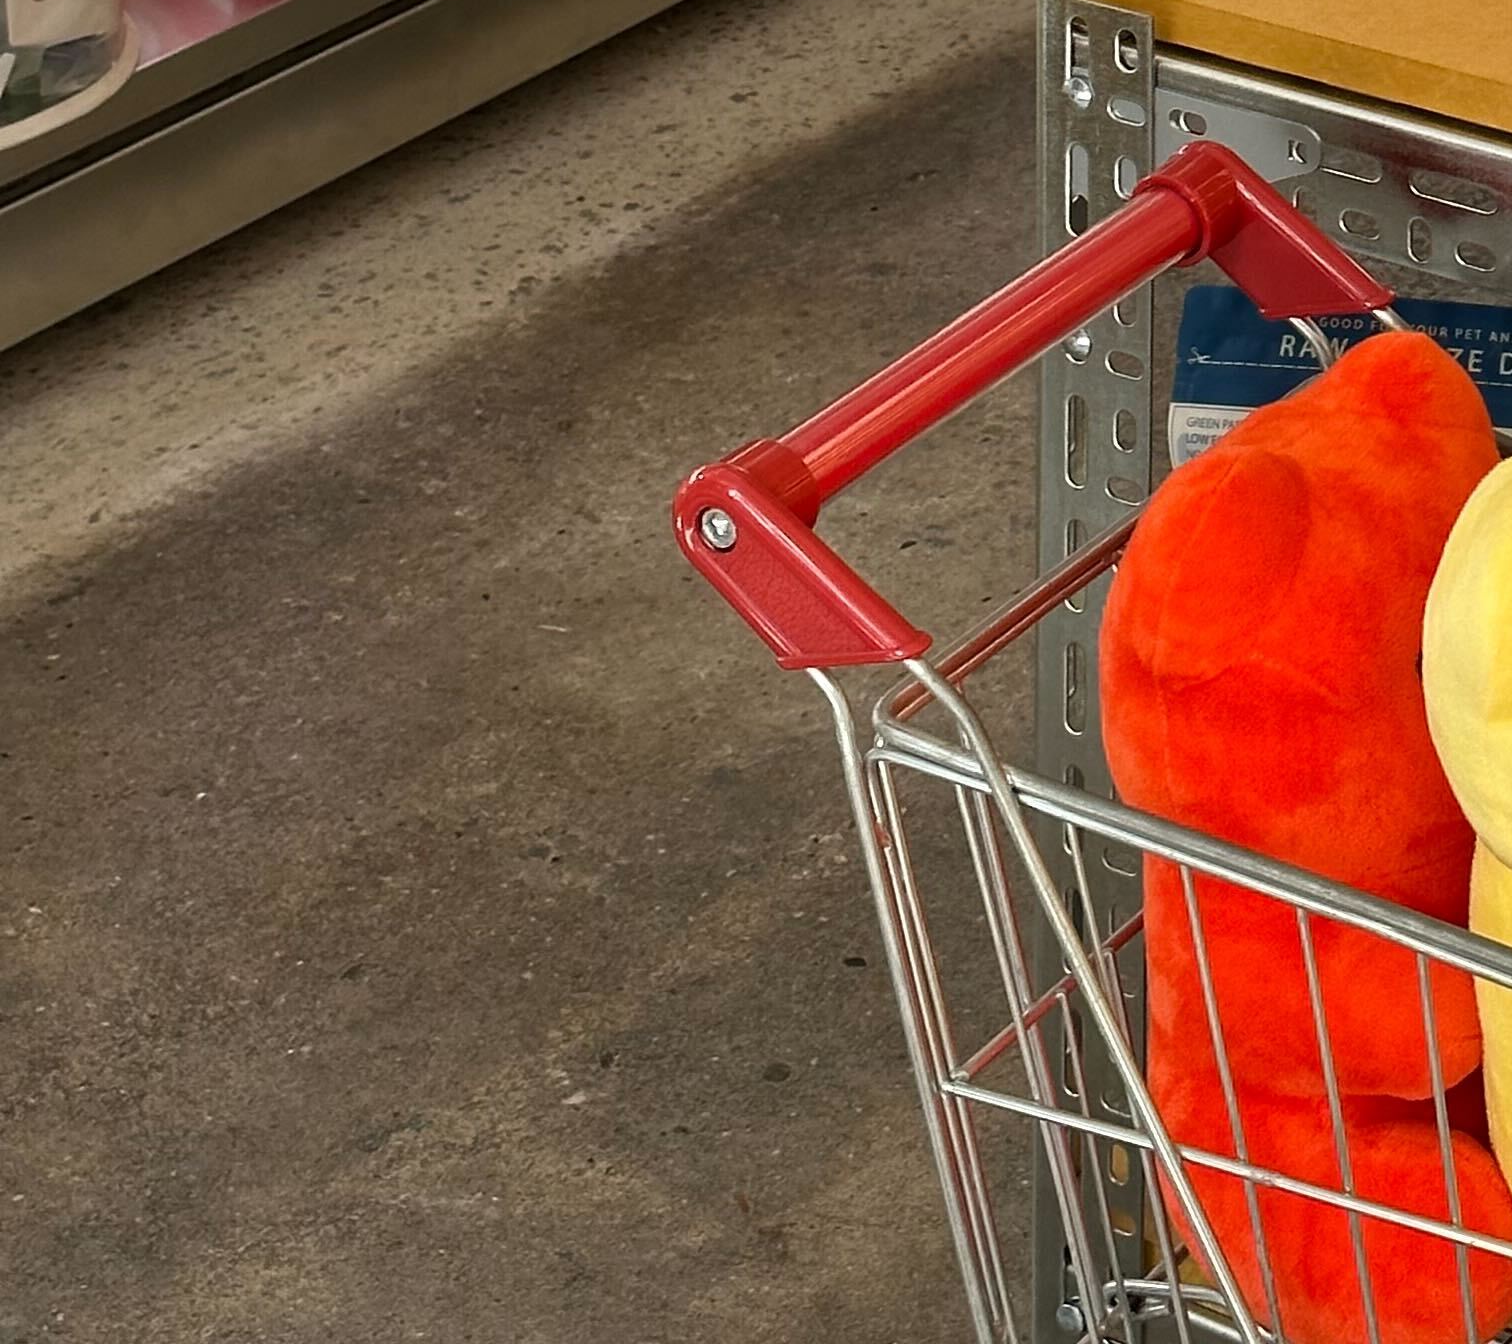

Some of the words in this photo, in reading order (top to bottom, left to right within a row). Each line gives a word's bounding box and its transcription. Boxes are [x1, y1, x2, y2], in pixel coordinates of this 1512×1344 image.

[1319, 315, 1365, 331] GOOD
[1455, 327, 1481, 341] PET
[1185, 416, 1220, 430] GREEN
